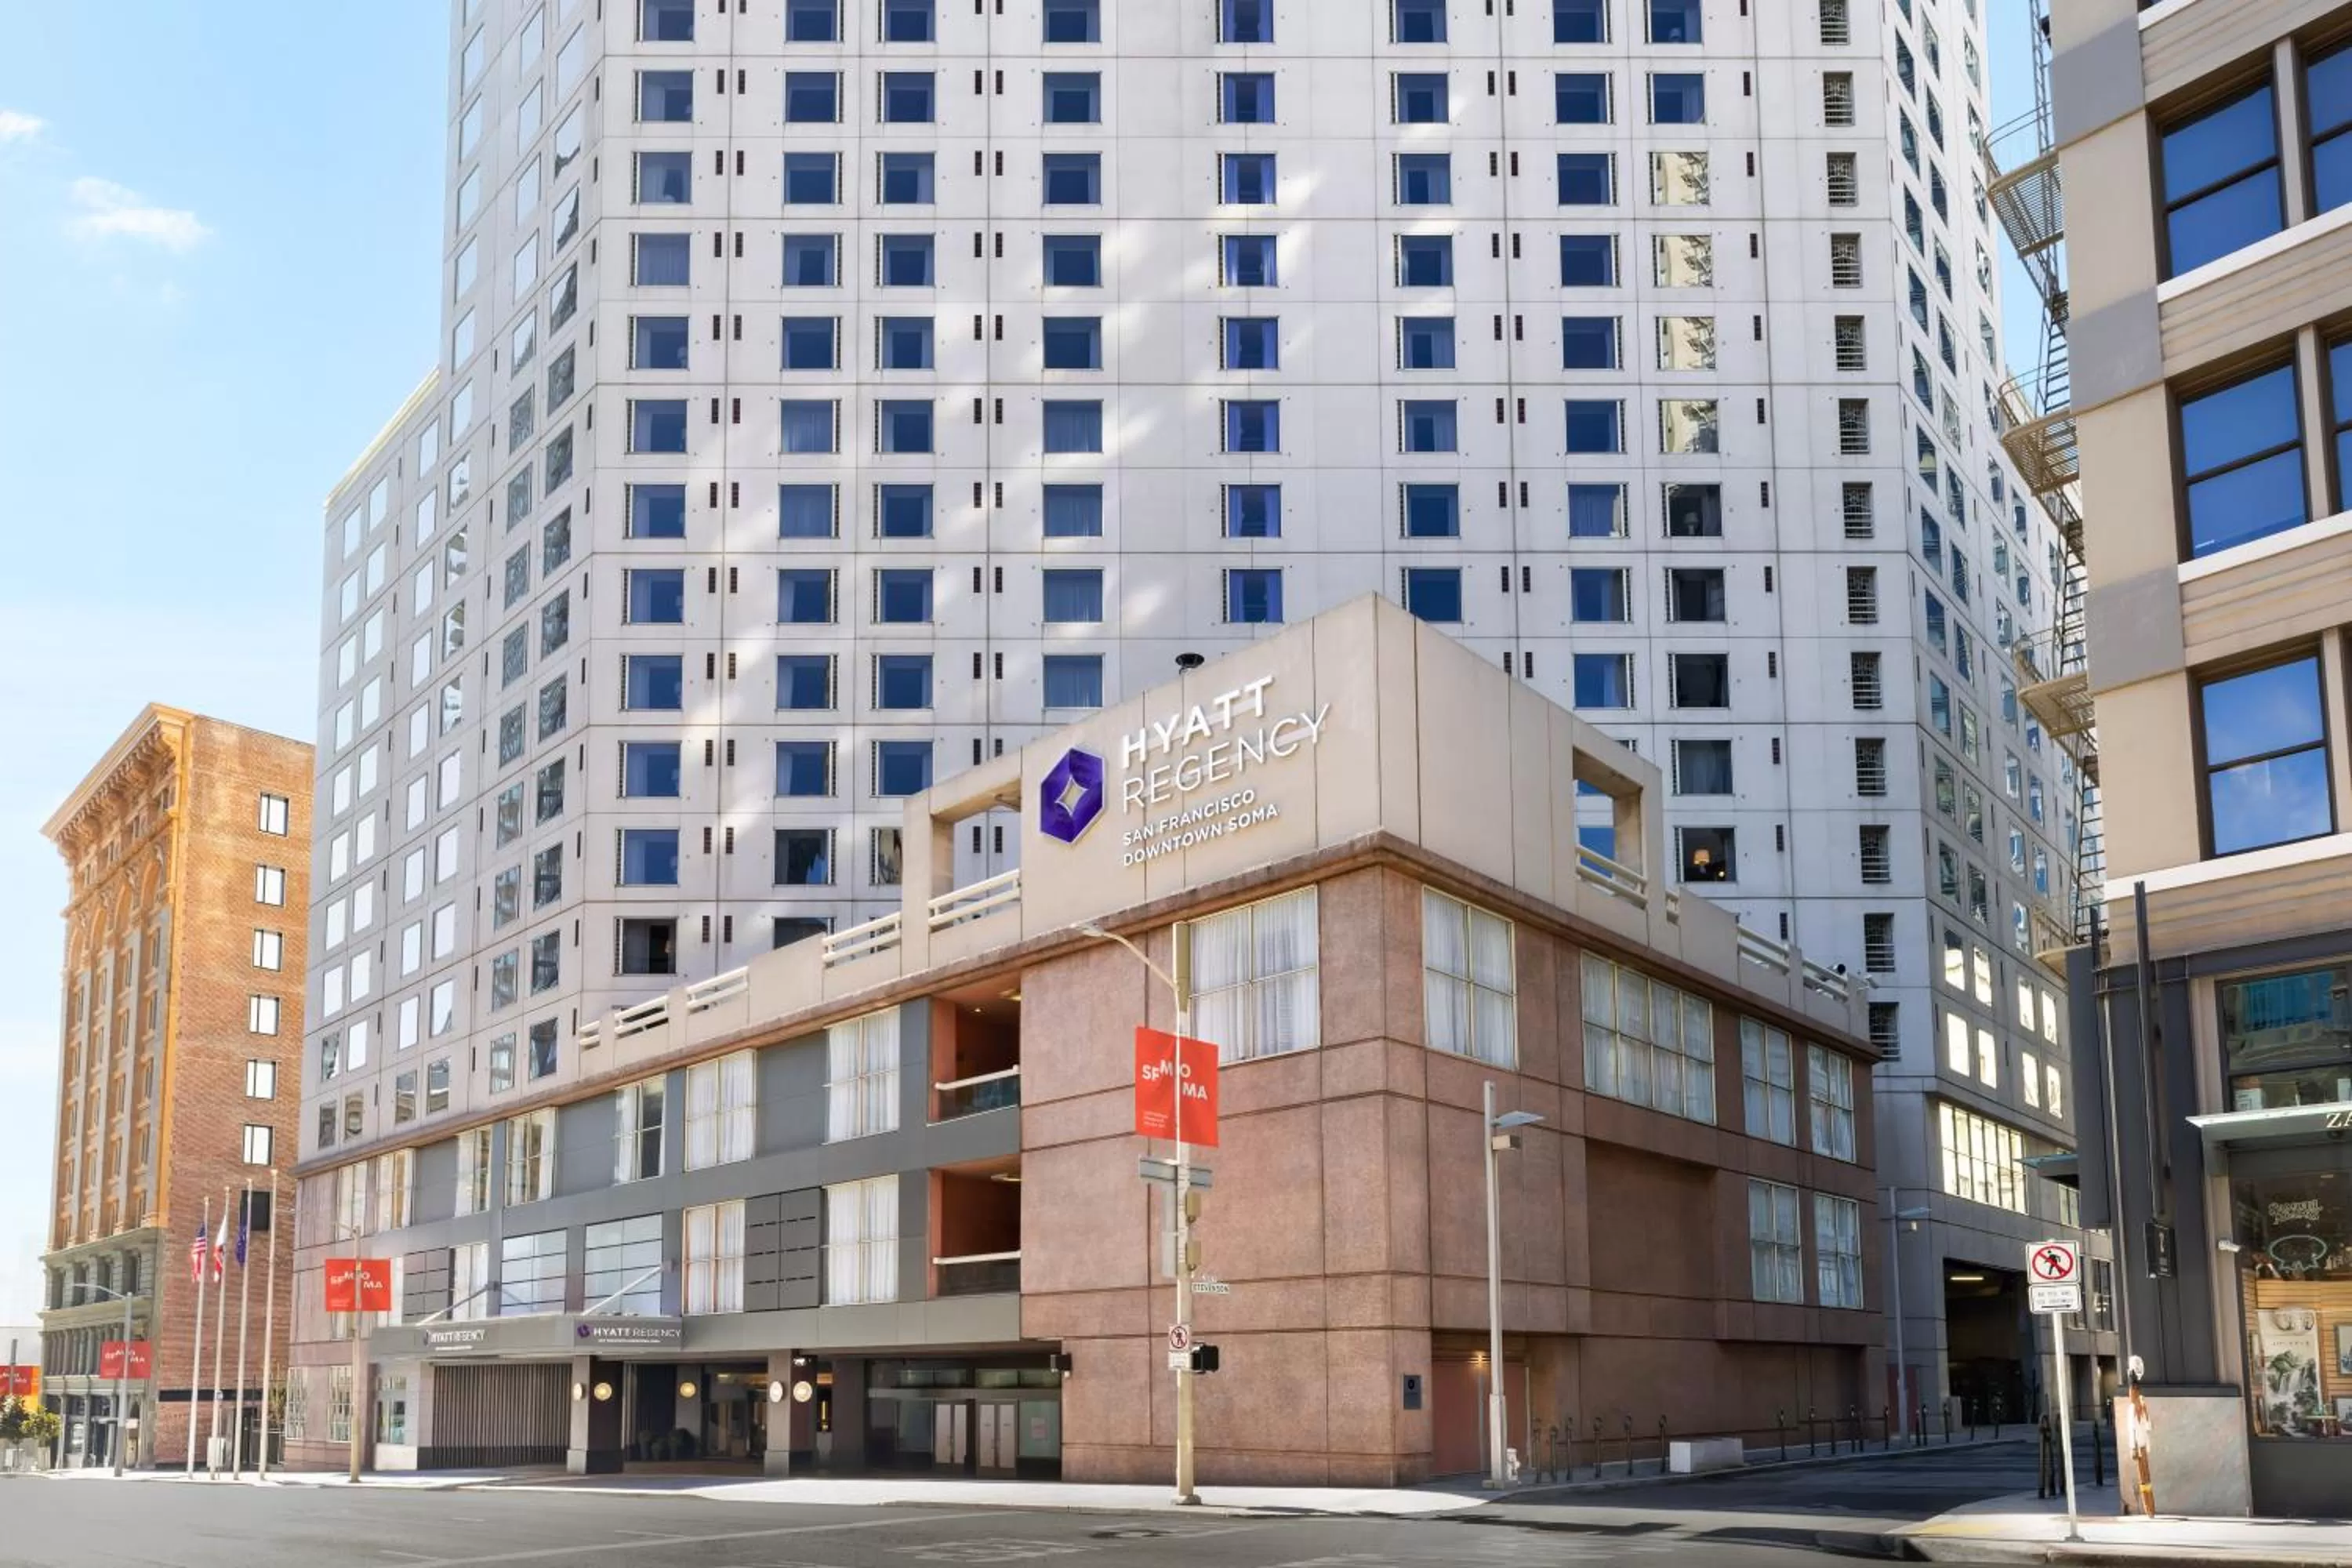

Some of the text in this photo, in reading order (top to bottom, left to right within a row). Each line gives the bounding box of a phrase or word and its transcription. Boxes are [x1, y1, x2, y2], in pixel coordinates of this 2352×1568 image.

[1122, 674, 1274, 769] HYATT
[1123, 702, 1331, 815] REGENCY
[1122, 789, 1255, 847] SAN FRANCISCO
[1123, 804, 1279, 867] DOWNTOWN SOMA
[593, 1327, 681, 1338] HYATT REGENCY
